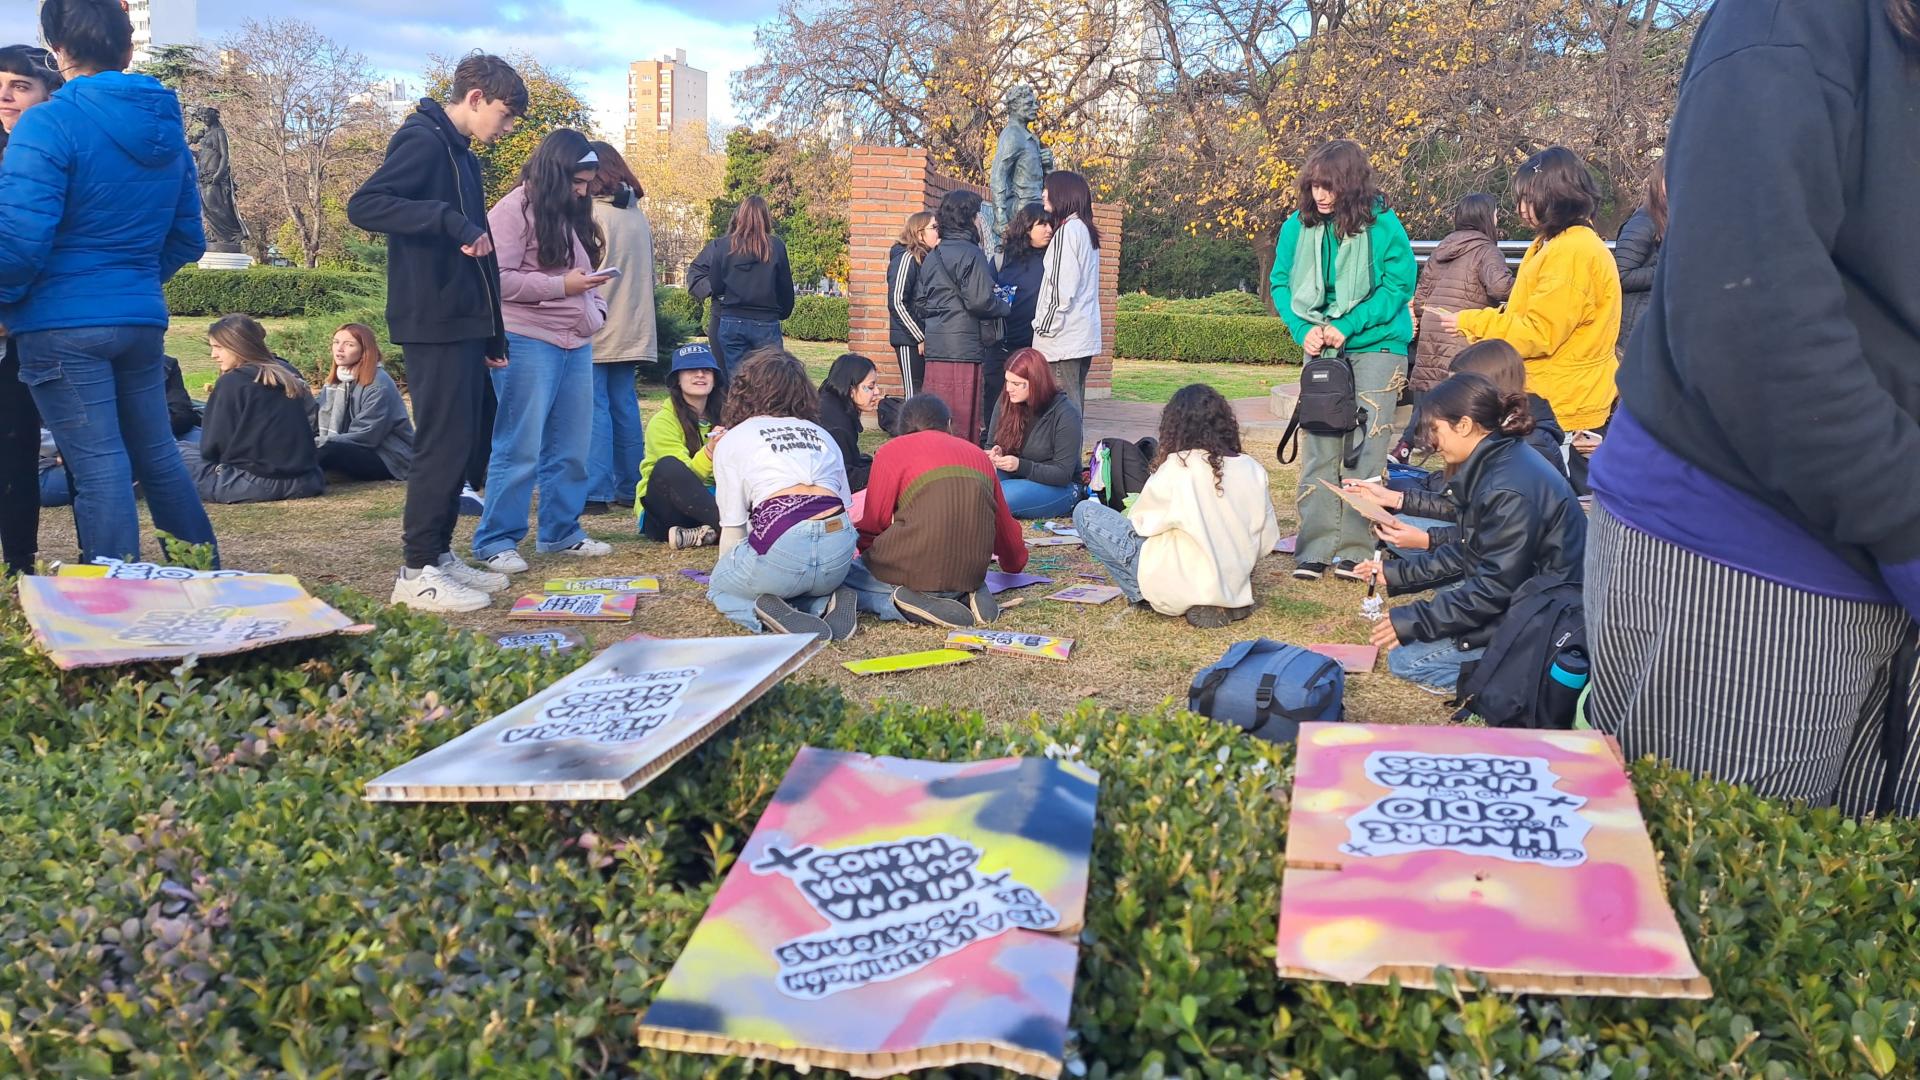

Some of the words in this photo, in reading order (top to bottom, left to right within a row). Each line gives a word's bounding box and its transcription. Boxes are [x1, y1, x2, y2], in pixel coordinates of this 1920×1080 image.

[561, 684, 682, 705] MENOS
[502, 715, 667, 744] MEMORIA
[1379, 756, 1531, 776] MENOS
[1375, 771, 1477, 788] UNA
[1486, 776, 1537, 793] NI
[1377, 798, 1536, 822] ODIO
[1360, 821, 1558, 852] HAMBRE
[810, 837, 948, 879] MENOS
[811, 849, 975, 898] JUBILADA
[925, 873, 970, 901] NI
[996, 887, 1035, 906] DE
[826, 886, 920, 920] UNA
[977, 911, 1005, 931] A
[1007, 908, 1055, 926] NO
[775, 901, 979, 967] MORATORIAS
[939, 923, 978, 949] LA
